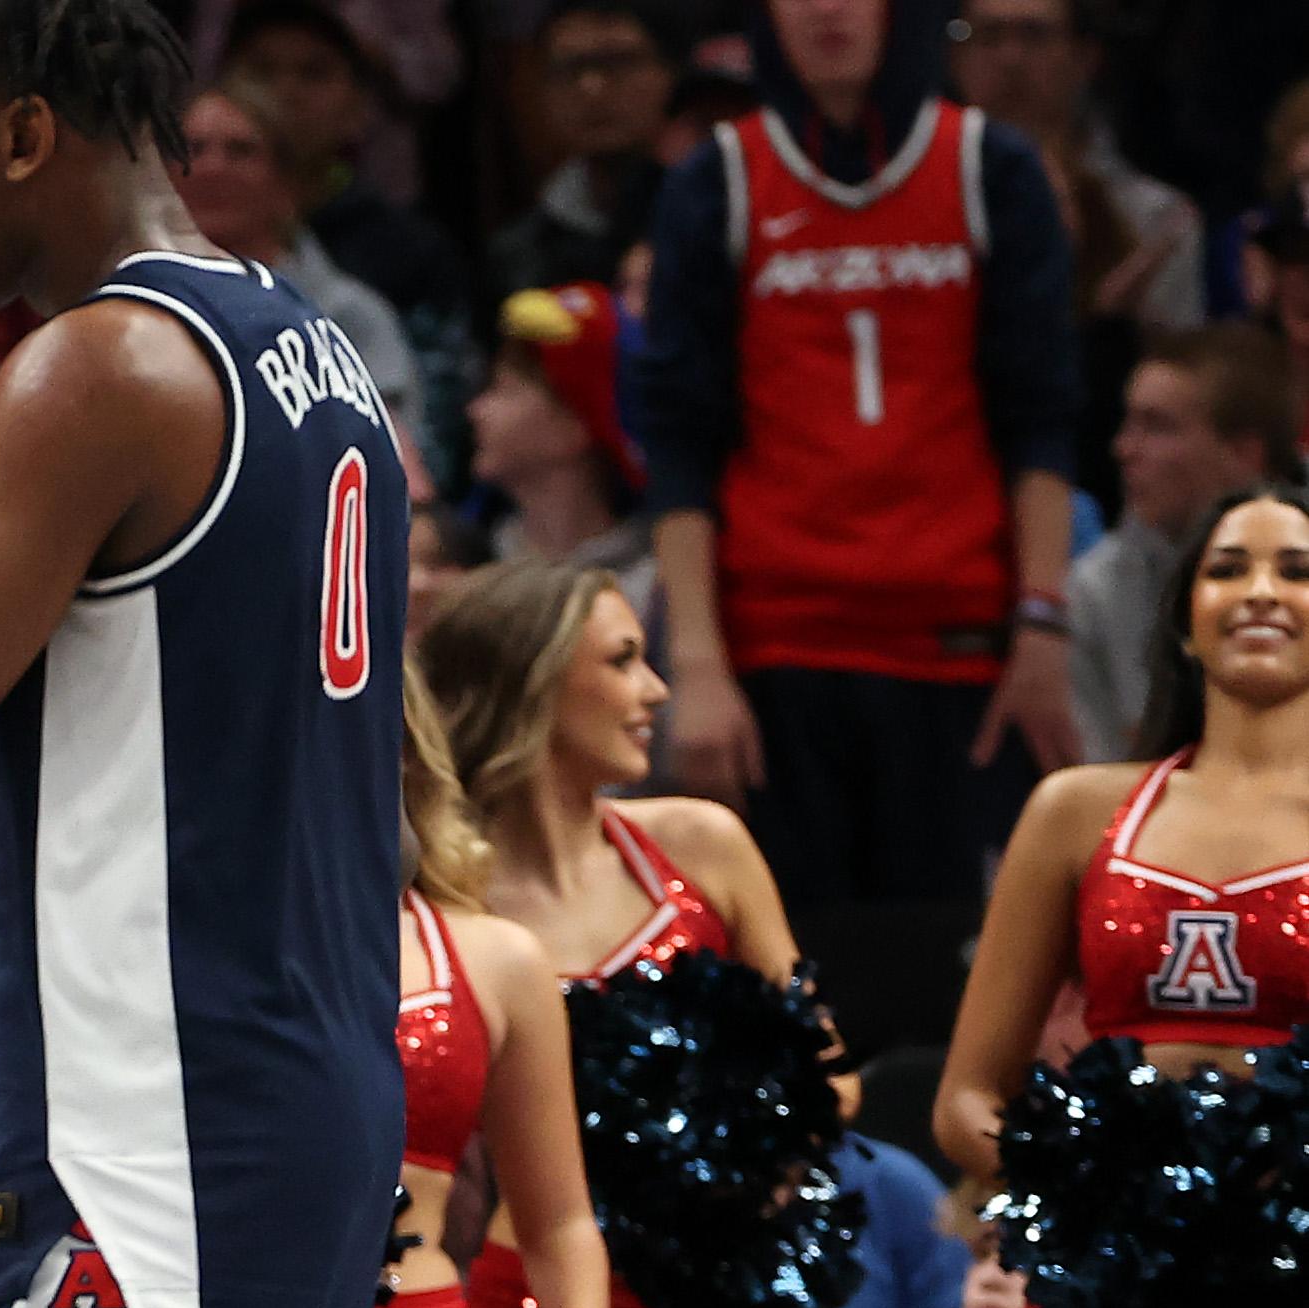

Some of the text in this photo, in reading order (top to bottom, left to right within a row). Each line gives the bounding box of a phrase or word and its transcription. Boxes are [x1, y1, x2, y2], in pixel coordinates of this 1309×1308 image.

[844, 308, 884, 426] 1
[319, 446, 370, 700] 0
[1147, 909, 1257, 1012] A
